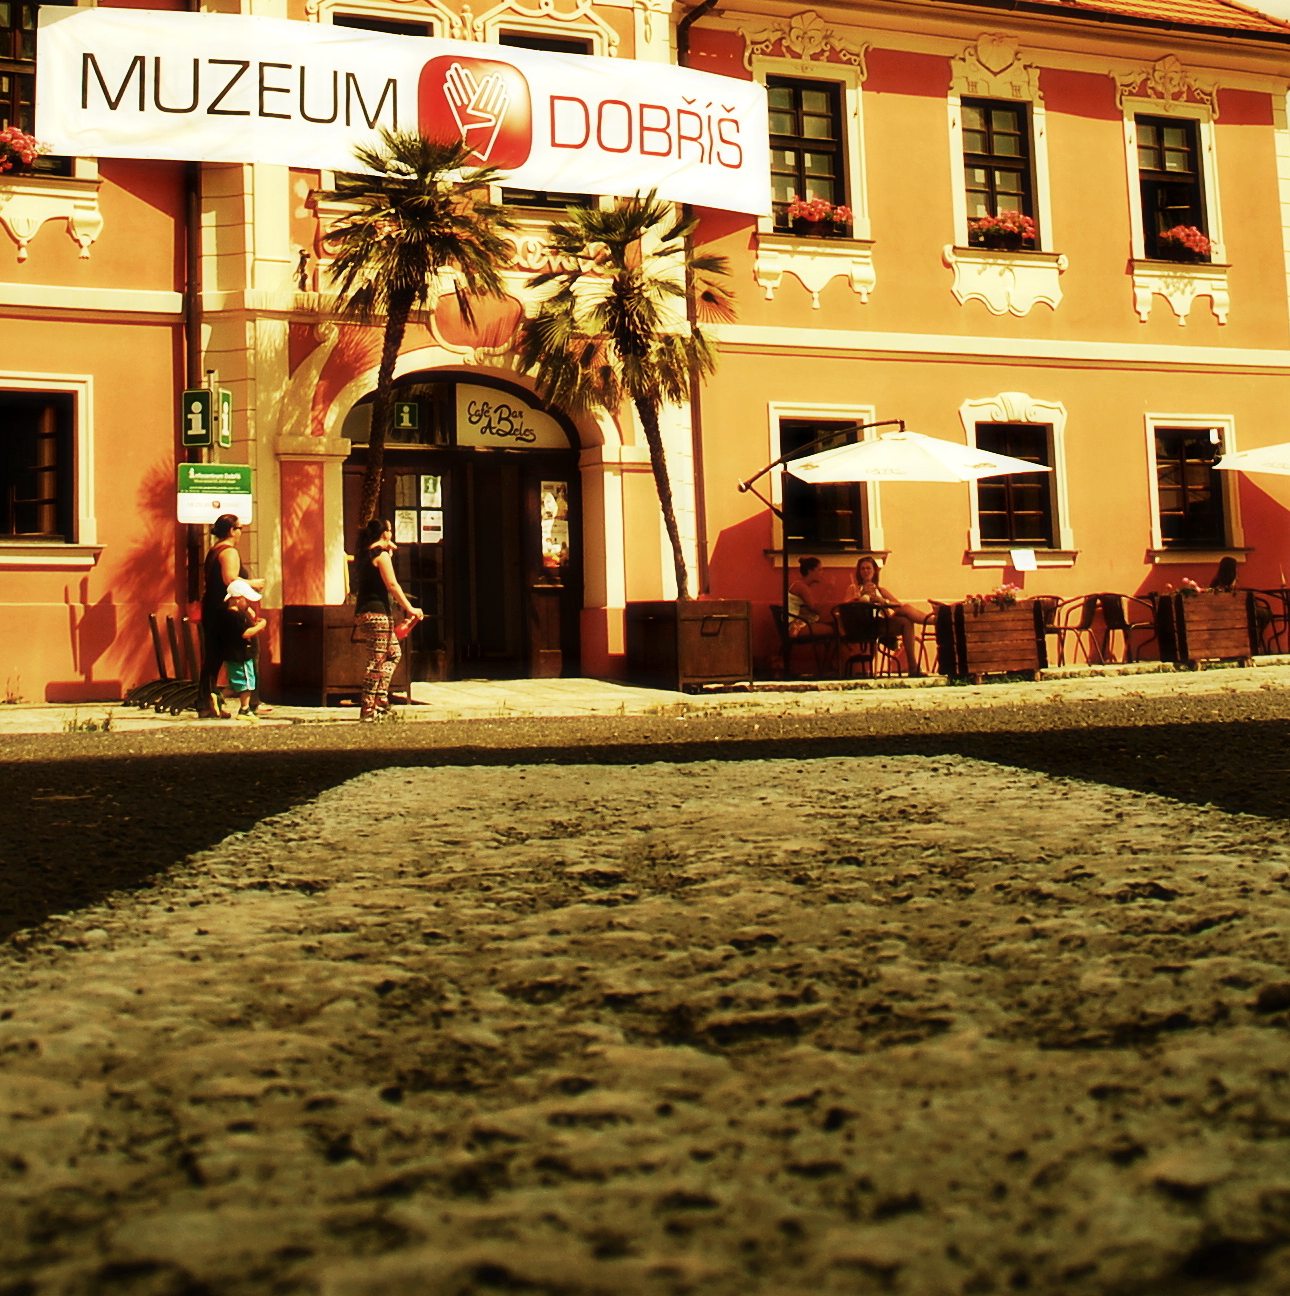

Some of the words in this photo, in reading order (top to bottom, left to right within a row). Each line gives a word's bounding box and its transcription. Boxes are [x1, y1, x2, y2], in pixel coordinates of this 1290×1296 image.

[81, 52, 398, 133] MUZEUM
[549, 94, 743, 169] DOBŘÍŠ
[467, 400, 493, 425] Café
